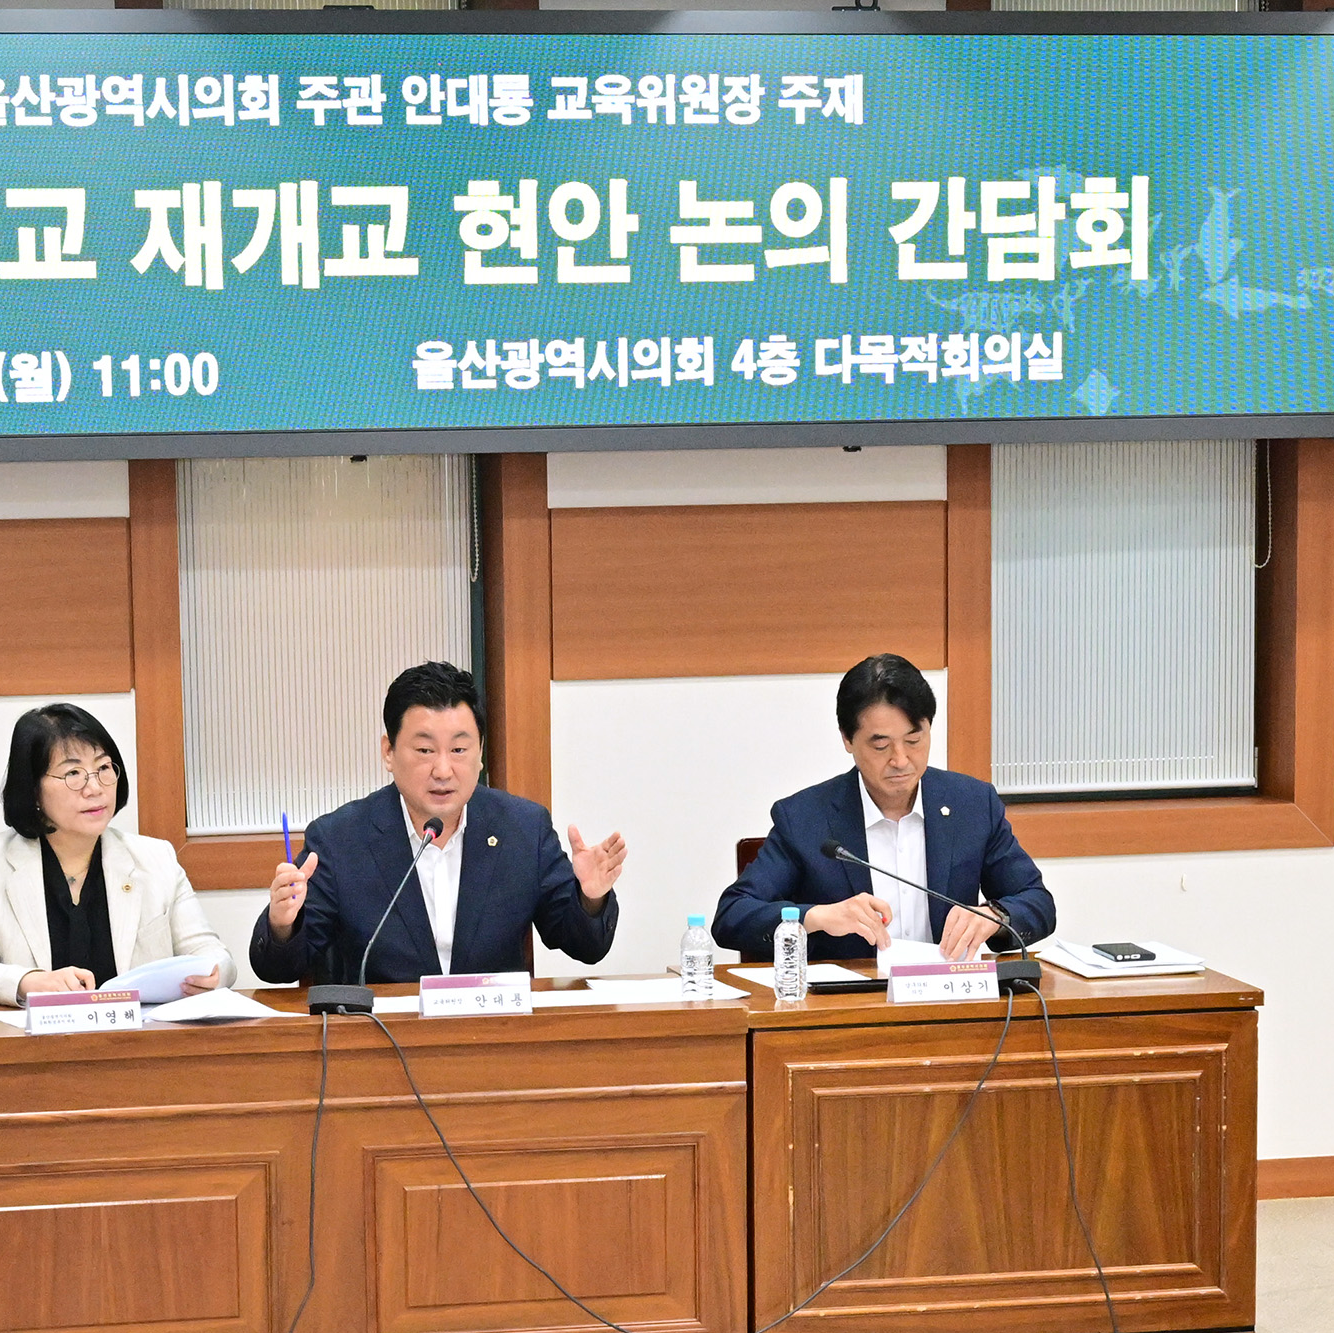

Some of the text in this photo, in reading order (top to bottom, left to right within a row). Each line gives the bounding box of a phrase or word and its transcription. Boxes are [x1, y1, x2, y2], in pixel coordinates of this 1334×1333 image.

[296, 74, 387, 126] 주관
[402, 73, 534, 126] 안대룡
[547, 73, 766, 125] 교육위원장
[778, 73, 864, 125] 주재
[130, 180, 419, 290] 재개교
[453, 178, 639, 285] 현안
[670, 177, 848, 284] 논의
[888, 175, 1150, 282] 간담회
[92, 352, 219, 397] 11:00
[412, 331, 1064, 390] 울산광역시의회 4층 다목적회의실
[943, 980, 989, 994] 이상기
[87, 1008, 135, 1025] 이영해
